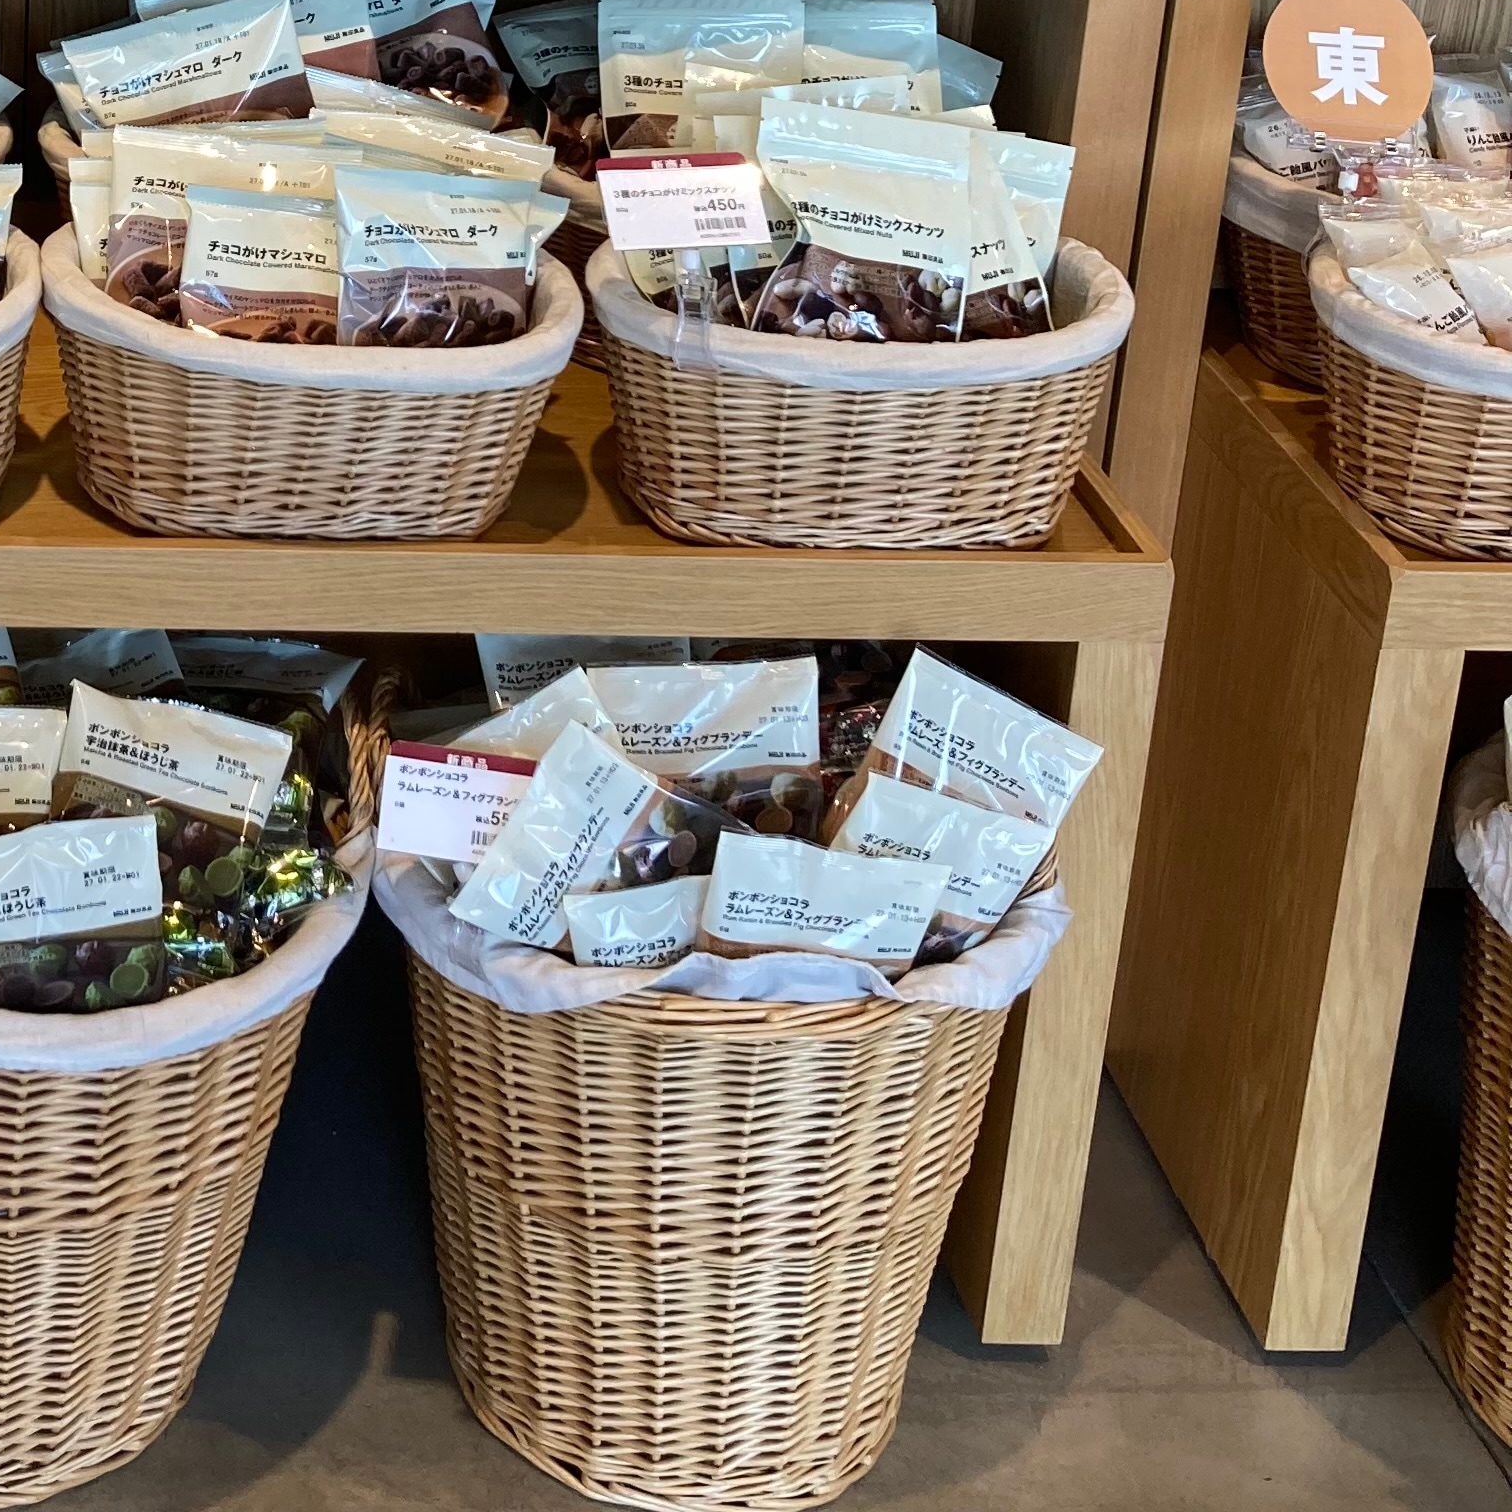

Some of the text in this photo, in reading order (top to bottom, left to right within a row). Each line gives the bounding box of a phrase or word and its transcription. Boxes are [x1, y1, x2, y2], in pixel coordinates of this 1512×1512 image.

[99, 50, 243, 98] チョコがけマシュマロ ダーク
[1307, 26, 1389, 105] 東
[624, 75, 683, 89] 3種のチョコ
[364, 224, 498, 238] チョコがけマシュマロ ダーク
[790, 200, 945, 239] 3種のチョコがけミックスナッツ
[208, 240, 326, 264] チョコがけマシュマロ
[86, 735, 180, 771] 宇治抹茶&ほうじ茶
[446, 754, 488, 770] 新商品
[398, 781, 518, 806] ラムレーズン&フィグブラン
